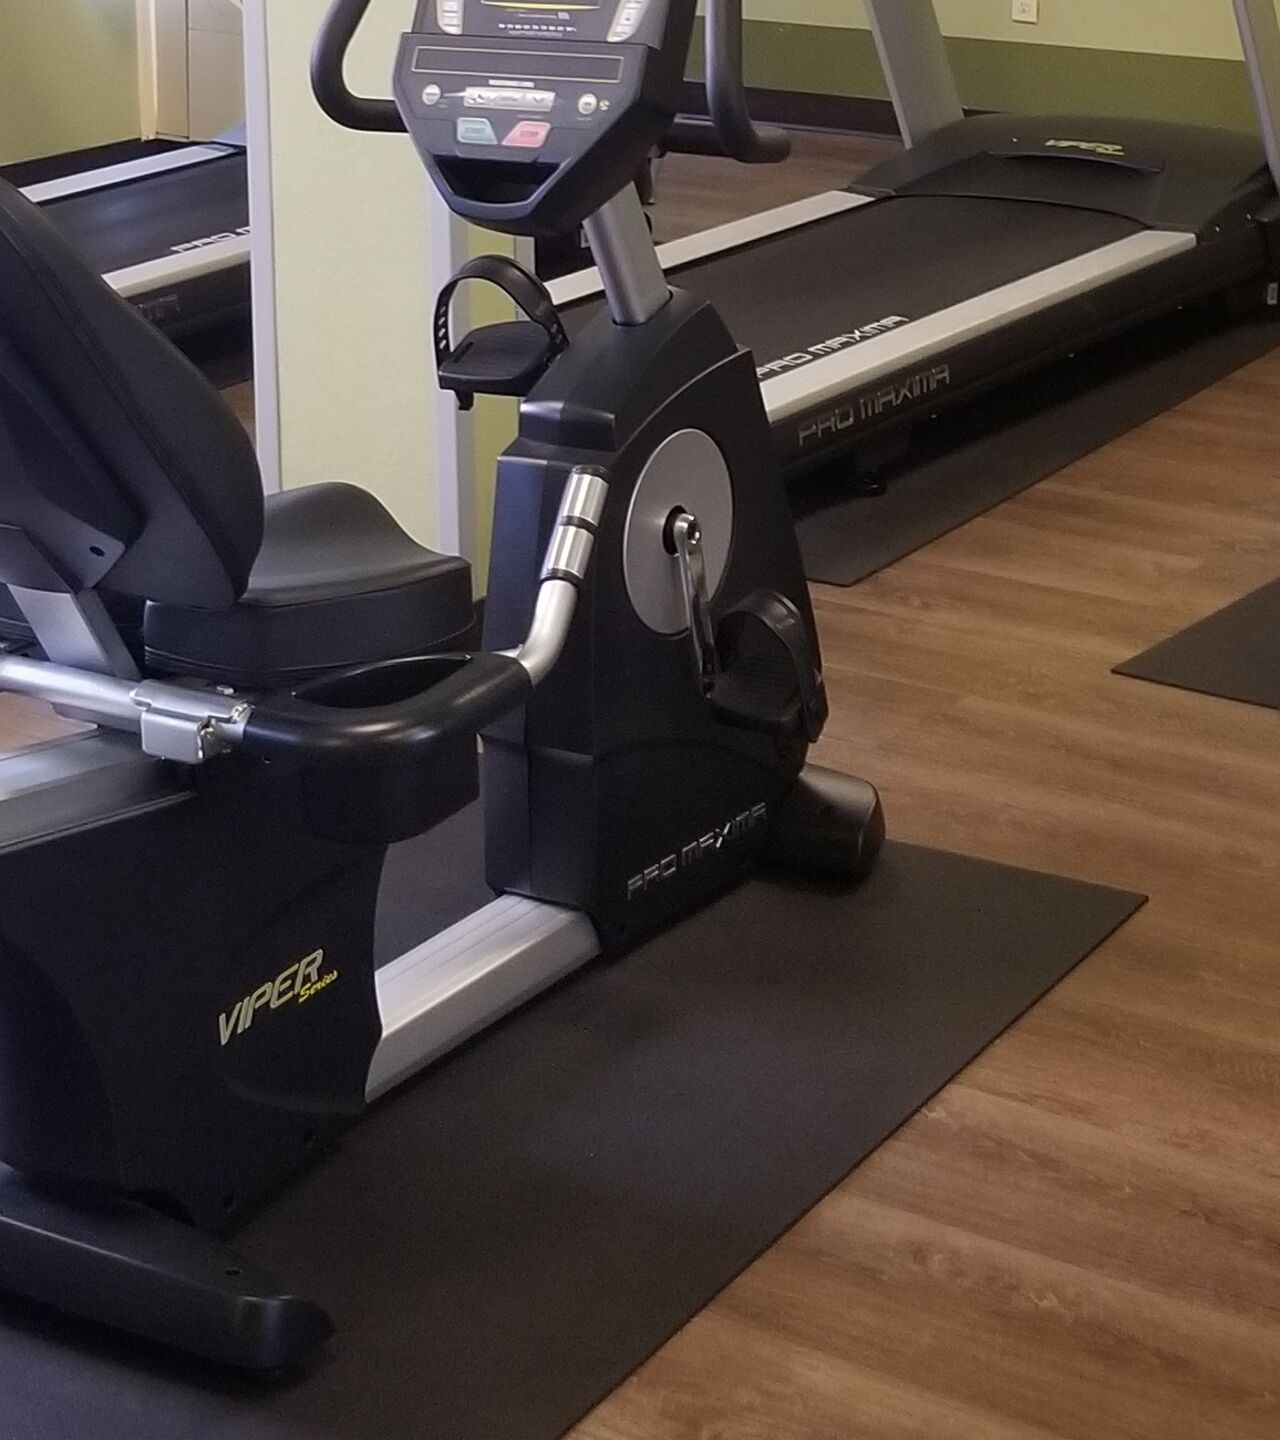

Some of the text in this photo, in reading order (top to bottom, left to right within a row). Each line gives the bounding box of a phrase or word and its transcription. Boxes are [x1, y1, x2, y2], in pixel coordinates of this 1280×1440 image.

[756, 315, 910, 378] PRO MAXIMA
[860, 363, 951, 419] MAXIMA
[627, 853, 677, 901] PRO
[218, 948, 324, 1046] VIPER
